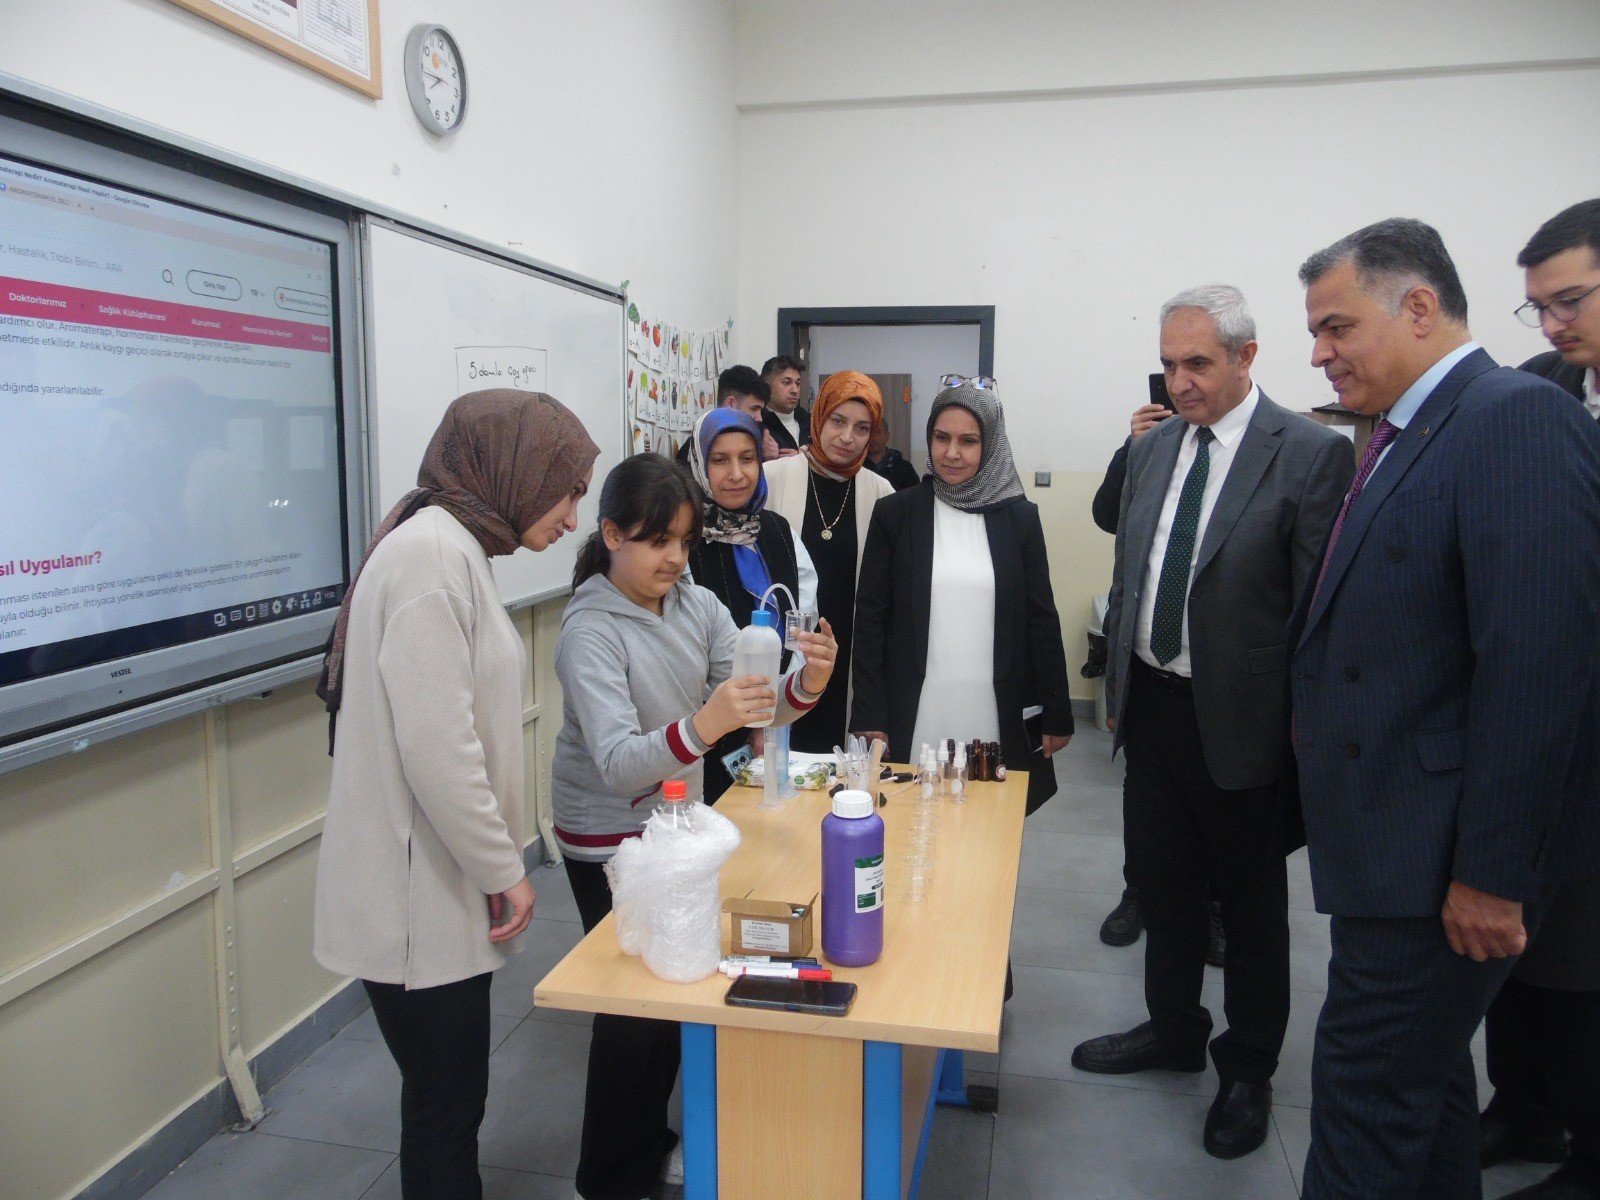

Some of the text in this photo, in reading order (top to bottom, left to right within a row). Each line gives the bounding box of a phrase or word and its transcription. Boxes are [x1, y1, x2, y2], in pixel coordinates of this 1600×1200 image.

[8, 244, 49, 261] Hastalık,
[9, 292, 68, 308] Doktorlarımız
[98, 304, 121, 316] Sağlık
[122, 308, 167, 322] Kütüphanesi
[191, 318, 221, 329] Kurumsal
[36, 319, 57, 330] olur.
[58, 321, 115, 338] Aromaterapi,
[41, 336, 78, 350] etkilidir.
[79, 340, 101, 351] Anlık
[102, 342, 124, 356] kaygı
[469, 361, 478, 379] 5
[479, 361, 502, 377] damla
[41, 385, 104, 397] yararlanılabilir.
[20, 551, 102, 576] Uygulanır?
[32, 587, 70, 600] istenilen
[71, 584, 95, 594] alana
[96, 580, 116, 592] göre
[117, 574, 155, 588] uygulama
[19, 606, 53, 619] olduğu
[55, 601, 81, 613] bilinir.
[116, 589, 144, 604] yönelik
[110, 667, 132, 678] VESTEL
